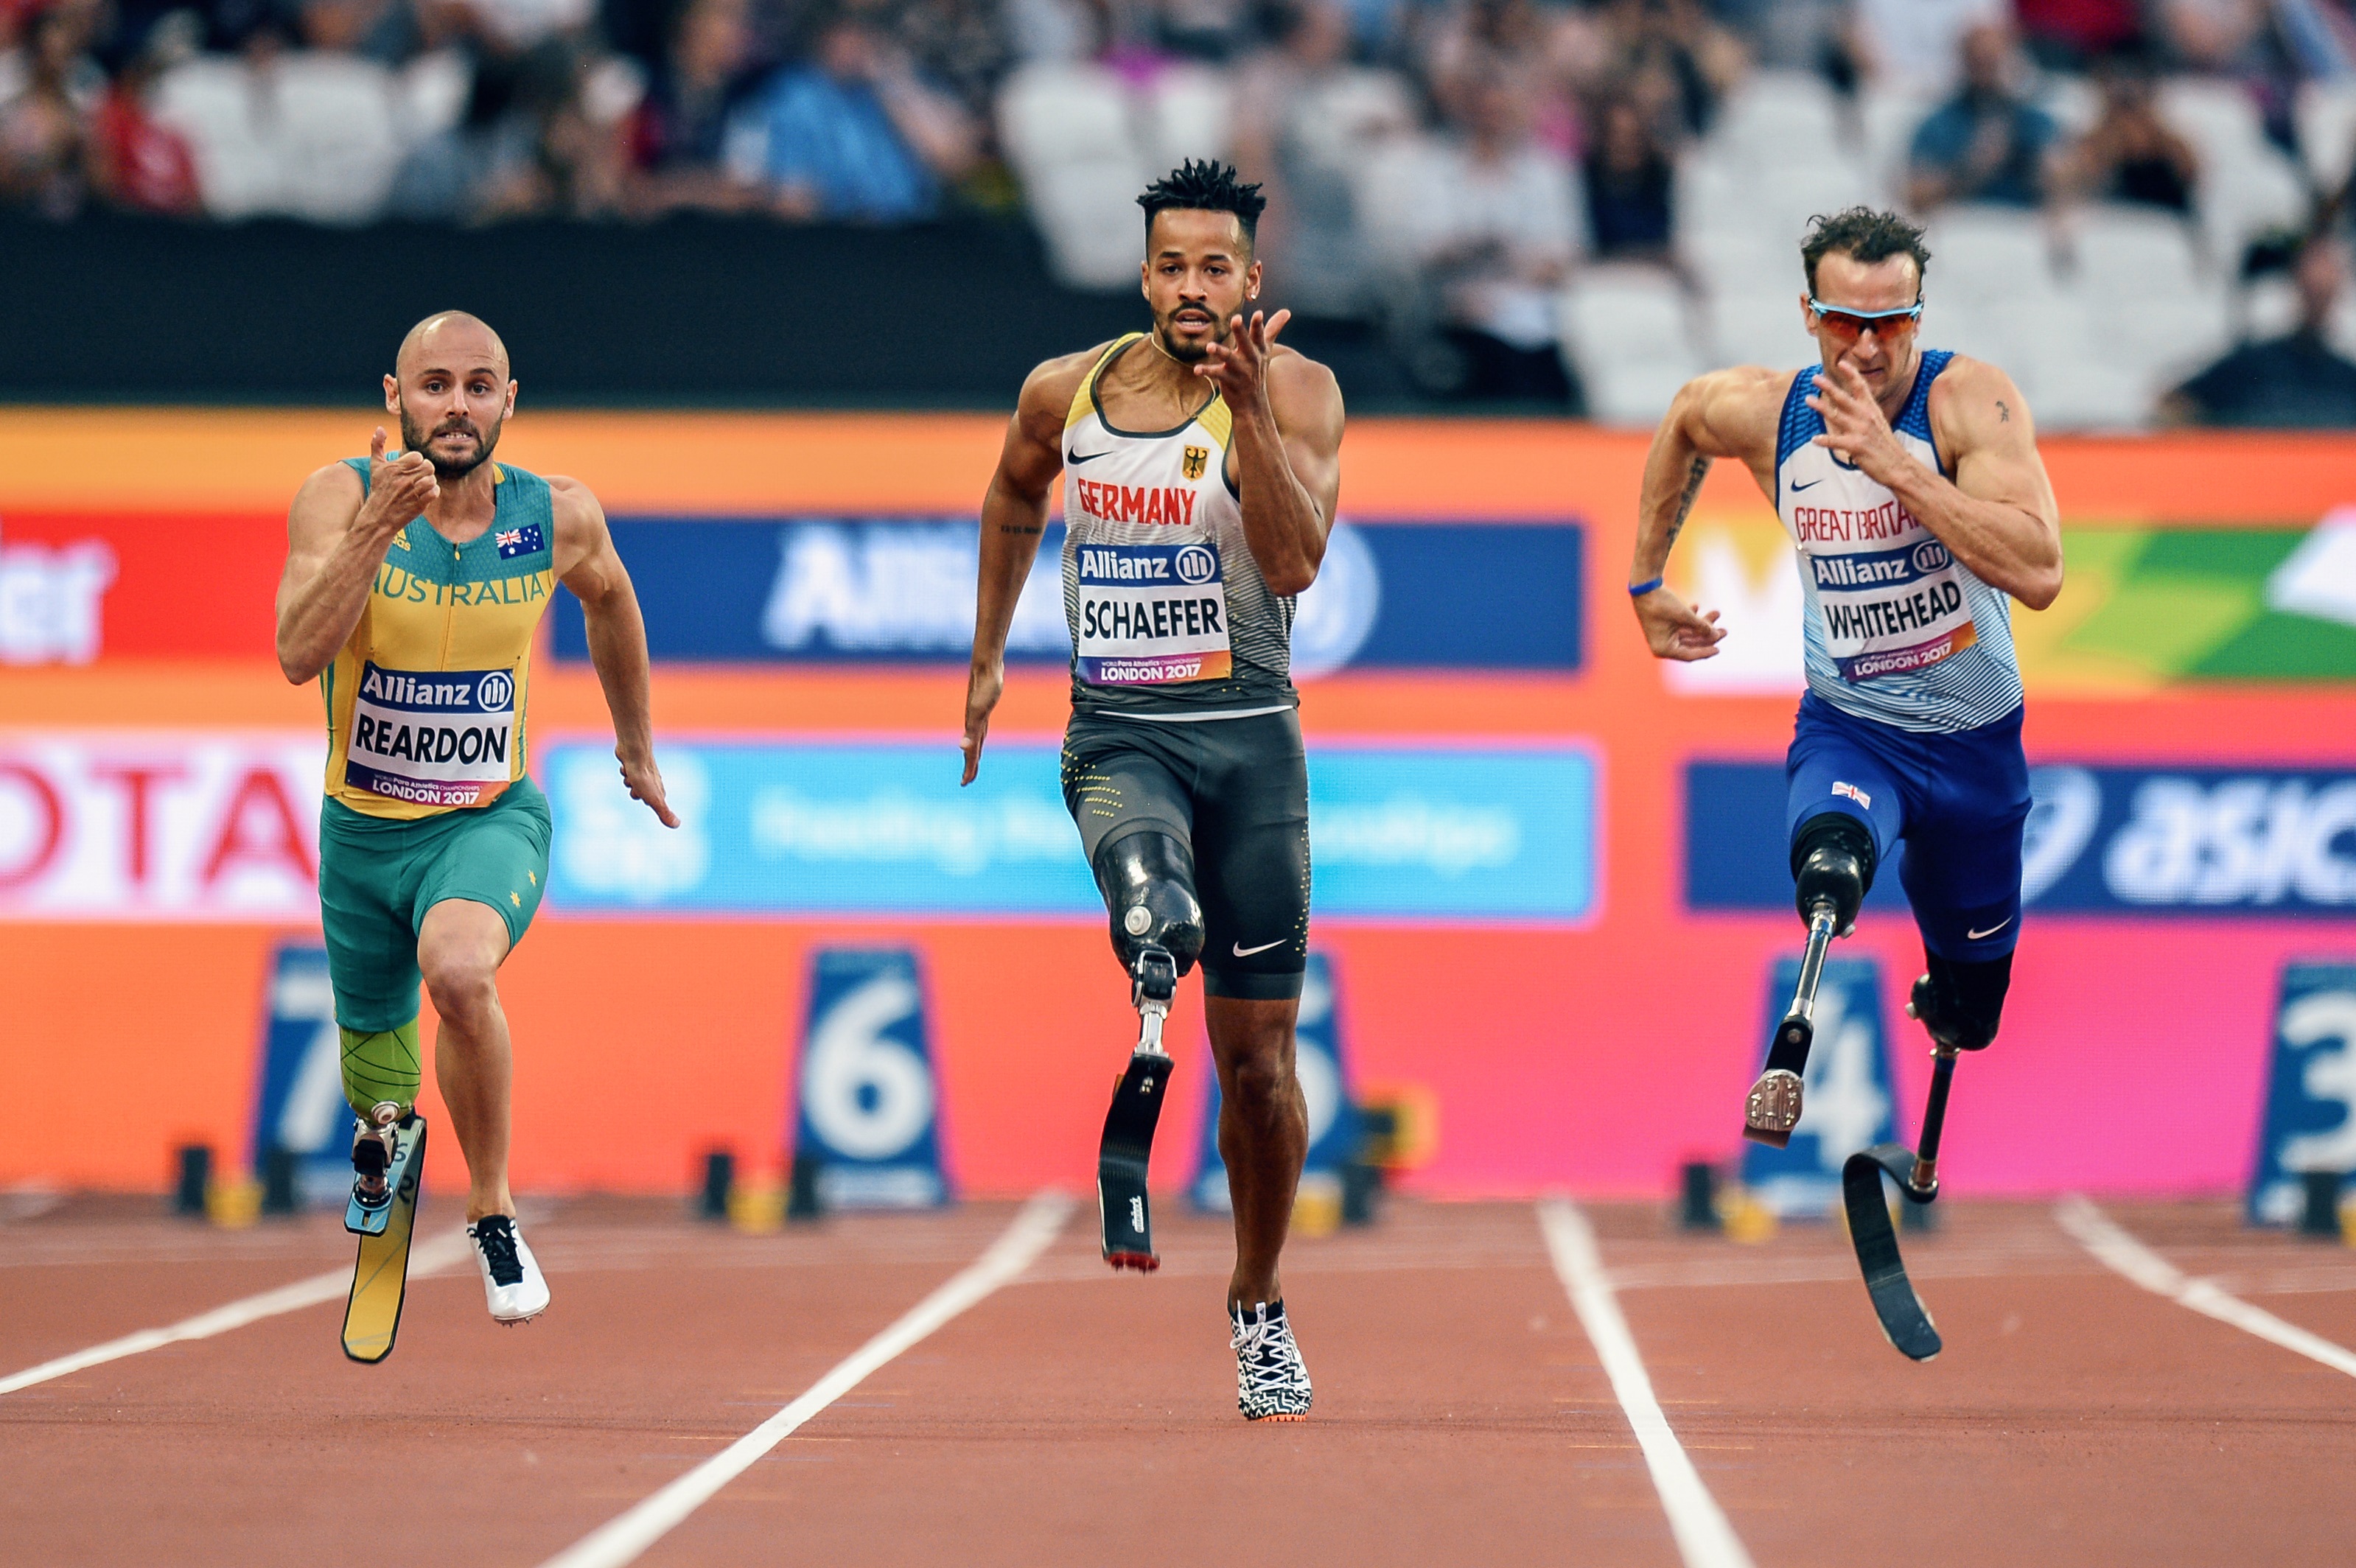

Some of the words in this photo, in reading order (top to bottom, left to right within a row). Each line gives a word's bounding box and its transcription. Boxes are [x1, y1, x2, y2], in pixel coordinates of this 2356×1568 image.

[1078, 477, 1196, 525] GERMANY
[1794, 506, 1852, 542] GREAT
[1856, 497, 1919, 541] BRITA
[1081, 550, 1170, 580] Allianz
[1814, 558, 1909, 586] Allianz
[1083, 598, 1223, 640] SCHAEFER
[1823, 580, 1962, 640] WHITEHEAD
[1101, 666, 1164, 681] LONDON
[1165, 663, 1202, 679] 2017
[1854, 654, 1920, 676] LONDON
[1920, 641, 1952, 664] 2017
[363, 669, 471, 706] Allianz
[355, 713, 508, 766] REARDON
[372, 779, 441, 804] LONDON
[443, 791, 480, 805] 2017
[802, 970, 934, 1161] 6
